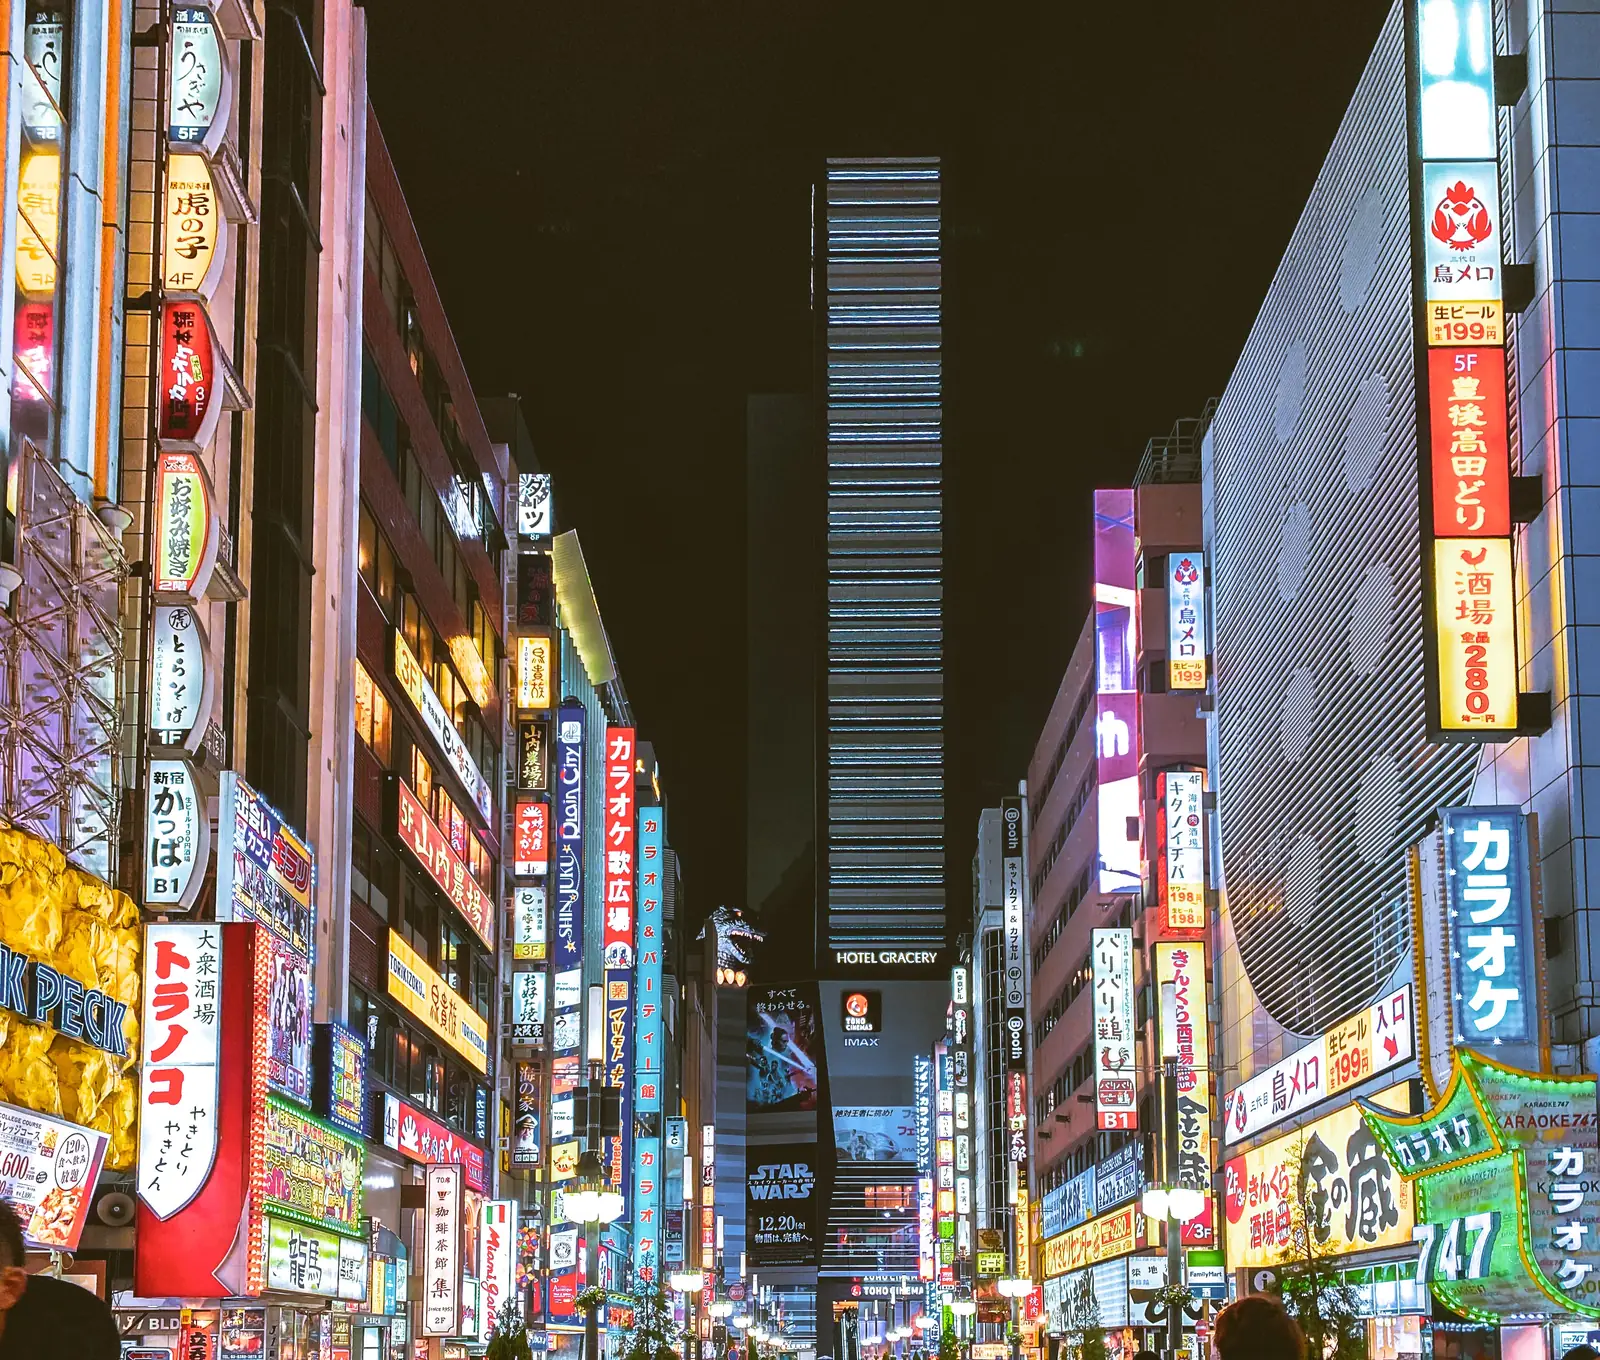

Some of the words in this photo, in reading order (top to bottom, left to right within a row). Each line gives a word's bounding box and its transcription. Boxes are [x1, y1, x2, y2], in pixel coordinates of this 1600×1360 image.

[176, 10, 205, 22] 酒処
[177, 128, 199, 140] 5F
[172, 192, 209, 260] 虎の子
[168, 273, 194, 285] 4F
[1433, 263, 1494, 284] 鳥メロ
[1434, 305, 1496, 320] 生ビール
[1454, 354, 1478, 372] 5F
[1447, 376, 1488, 532] 豊後高田どり
[525, 478, 545, 529] ダーツ
[168, 476, 191, 578] お好み焼き
[158, 580, 189, 591] 2階
[1455, 571, 1496, 626] 酒場
[1179, 607, 1196, 657] 鳥メロ
[1460, 631, 1491, 644] 全品
[166, 634, 188, 724] とらそば
[400, 650, 418, 694] 3F
[1174, 662, 1202, 670] 生ビール
[1177, 670, 1203, 682] 199
[1464, 645, 1490, 715] 280
[158, 731, 182, 744] 1F
[522, 724, 543, 782] 山内農場
[153, 771, 185, 785] 新宿
[527, 780, 538, 788] 5F
[1188, 775, 1200, 785] 4F
[151, 787, 185, 869] かっぱ
[236, 787, 271, 842] 出会い
[401, 795, 414, 833] 5F
[1004, 807, 1020, 850] Booth
[1169, 781, 1185, 879] キタノイチバ
[247, 830, 270, 865] カフェ
[518, 819, 532, 860] さかい
[607, 735, 632, 933] カラオケ歌広場
[272, 834, 309, 892] キラリ
[415, 814, 484, 934] 山内農場
[153, 877, 180, 894] B1
[1461, 820, 1519, 1032] カラオケ
[522, 945, 539, 956] 3F
[837, 952, 878, 964] HOTEL
[880, 952, 938, 964] GRACERY
[194, 929, 218, 1026] 大衆酒場
[611, 983, 627, 999] 薬
[767, 989, 796, 999] すべて
[35, 962, 127, 1057] PECK
[519, 974, 539, 1023] お好み焼
[756, 1001, 811, 1013] 終わらせる。
[1376, 994, 1405, 1034] 入口
[148, 940, 190, 1105] トラノコ
[513, 1024, 544, 1038] 大阪家
[1008, 1016, 1024, 1060] Booth
[1329, 1018, 1367, 1057] 生ビール
[844, 1038, 879, 1047] IMAX
[519, 1065, 535, 1112] 海の家
[1272, 1055, 1319, 1115] 鳥メロ
[384, 1106, 399, 1141] 4F
[1103, 1113, 1129, 1129] B1
[1251, 1097, 1269, 1113] 三代目
[22, 1119, 42, 1130] COURSE
[176, 1106, 206, 1177] やきとり
[1395, 1114, 1471, 1168] カラオケ
[148, 1119, 181, 1192] やきとん
[749, 1163, 814, 1180] STAR
[749, 1183, 814, 1200] WARS
[1248, 1160, 1289, 1208] きんくら
[758, 1215, 796, 1232] 12.20
[1135, 1212, 1145, 1238] 2F
[1250, 1208, 1275, 1250] 酒場
[1549, 1146, 1593, 1290] カラオケ
[755, 1233, 813, 1244] 物語は、完結へ。
[1412, 1211, 1493, 1285] 747
[863, 1286, 888, 1296] TOHO
[1201, 1287, 1212, 1297] 酒
[434, 1317, 446, 1325] 2F
